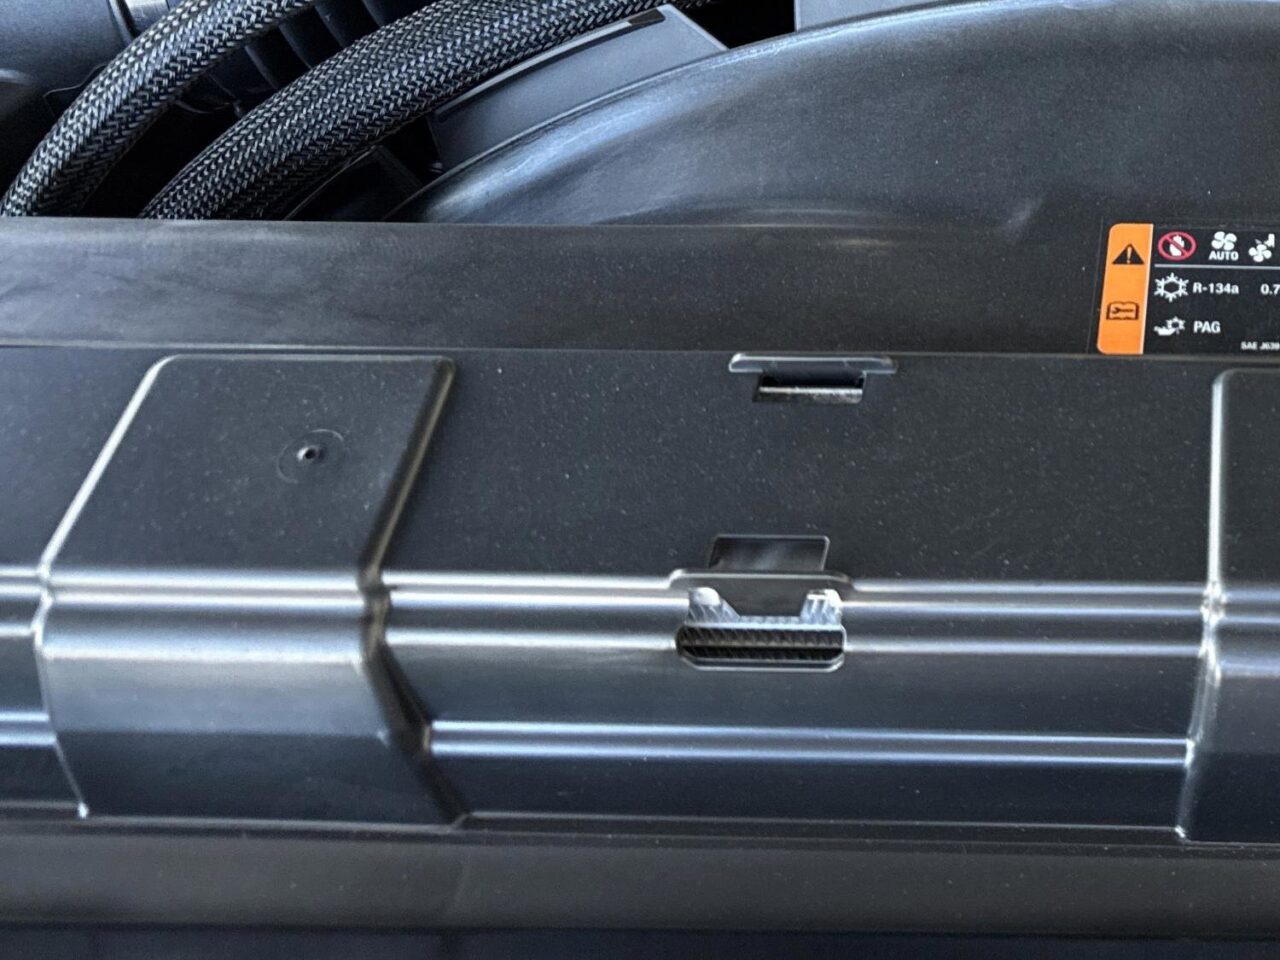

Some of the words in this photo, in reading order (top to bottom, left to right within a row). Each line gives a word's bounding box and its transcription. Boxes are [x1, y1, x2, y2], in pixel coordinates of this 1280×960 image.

[1208, 250, 1239, 261] AUTO
[1192, 282, 1239, 294] R-134a
[1193, 321, 1221, 334] PAG
[1240, 341, 1258, 351] SAE
